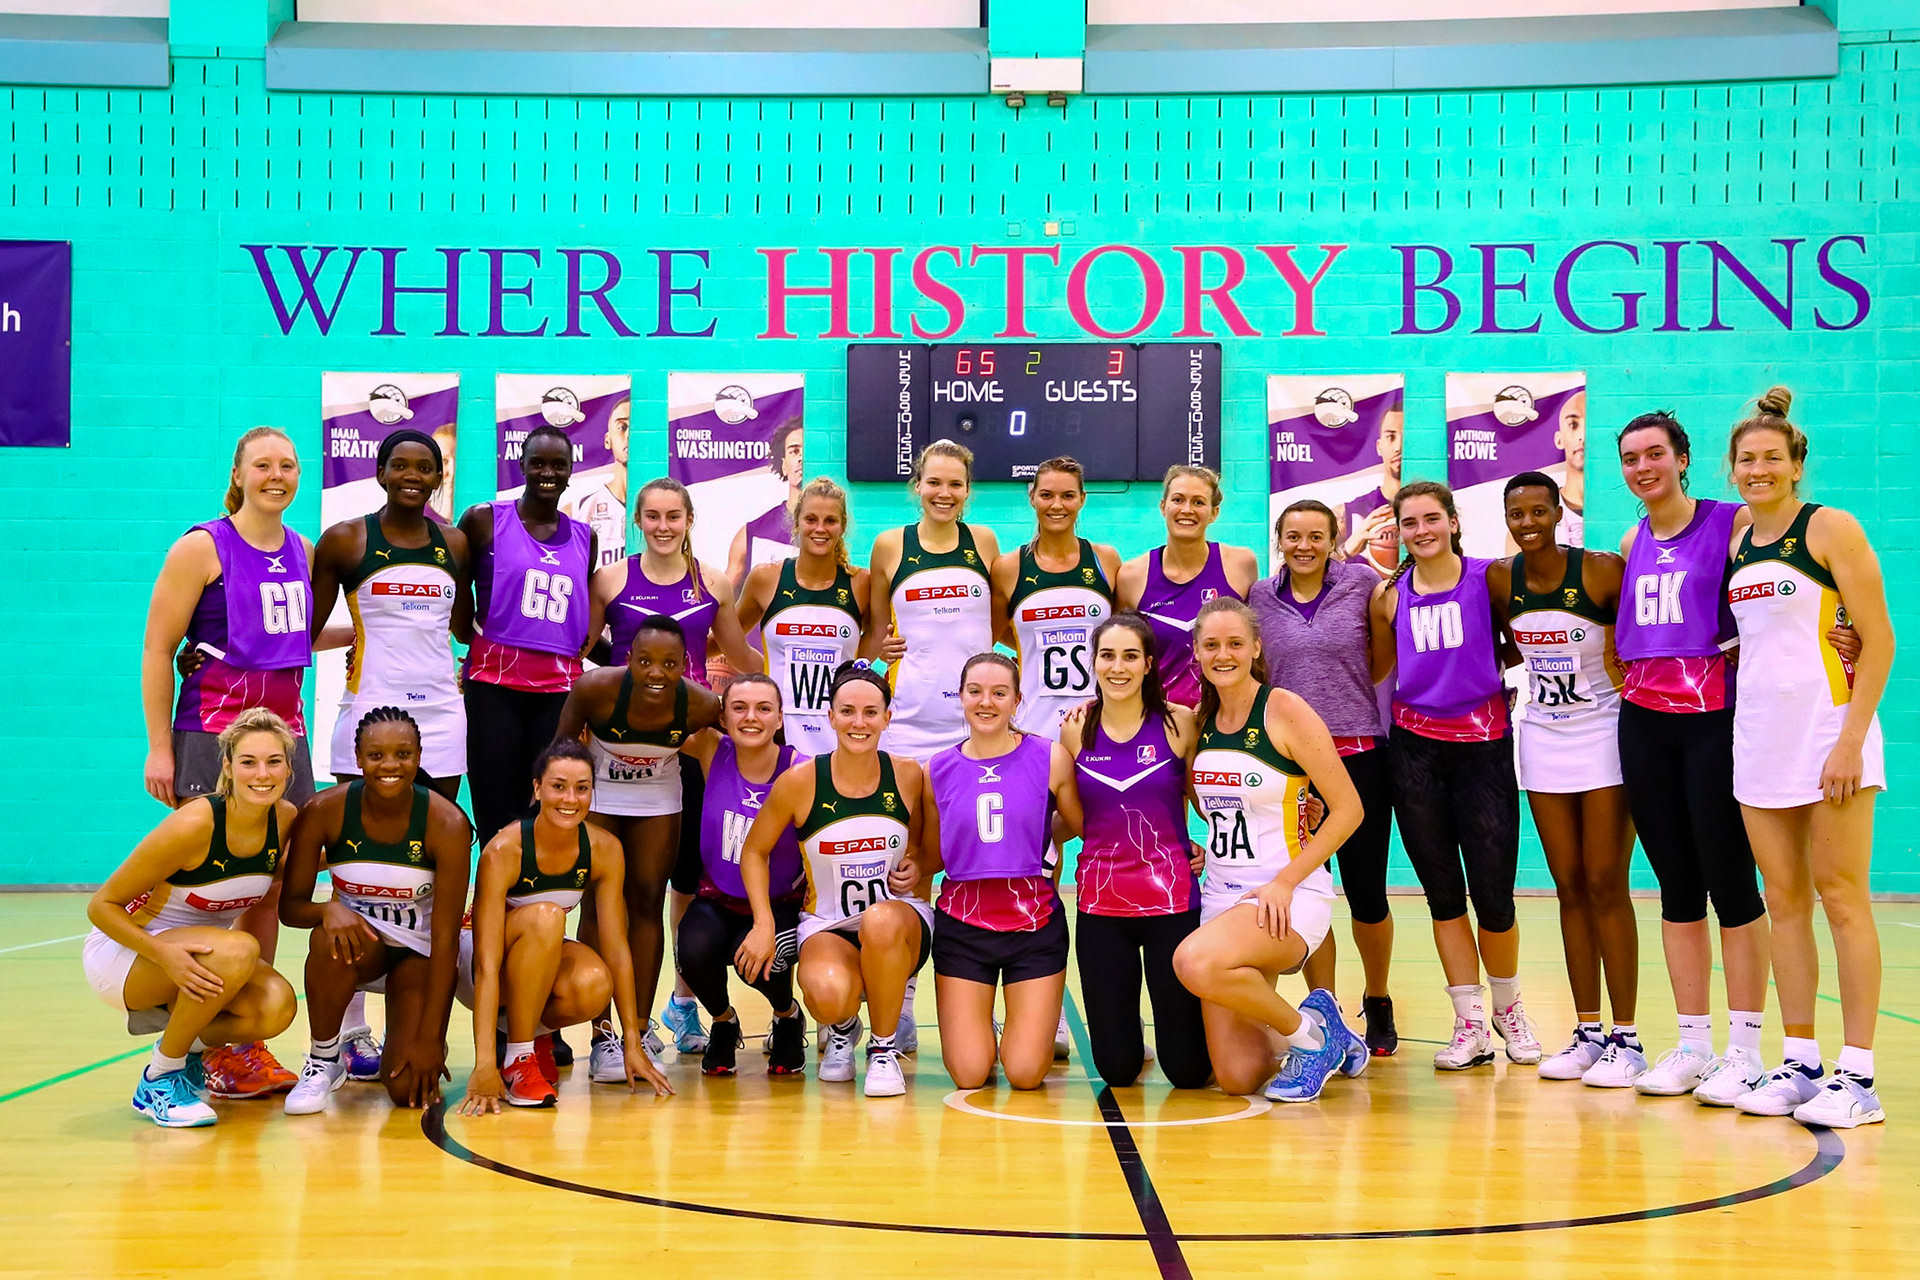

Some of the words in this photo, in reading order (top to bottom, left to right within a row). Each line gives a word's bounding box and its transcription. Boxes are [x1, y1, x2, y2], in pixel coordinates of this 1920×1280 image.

[240, 244, 718, 338] WHERE
[756, 244, 1347, 341] HISTORY
[1391, 235, 1872, 334] BEGINS
[2, 302, 21, 332] h
[956, 350, 995, 375] 65
[1025, 351, 1041, 375] 2
[1107, 350, 1123, 375] 3
[934, 380, 1004, 402] HOME
[1045, 380, 1137, 402] GUESTS
[1009, 410, 1027, 436] 0
[676, 429, 712, 440] CONNER
[1276, 432, 1295, 443] LEVI
[1454, 430, 1495, 443] ANTHONY
[331, 440, 381, 459] BRATK
[1276, 443, 1314, 463] NOEL
[1454, 442, 1498, 461] ROWE
[388, 584, 440, 597] SPAR
[520, 568, 574, 624] GS
[918, 586, 968, 599] SPAR
[1635, 570, 1688, 626] GK
[1731, 583, 1774, 601] SPAR
[259, 580, 306, 635] GD
[401, 602, 430, 611] Telkom
[933, 607, 961, 615] Telkom
[1035, 606, 1085, 619] SPAR
[789, 624, 836, 636] SPAR
[1409, 600, 1465, 653] WD
[1044, 630, 1085, 644] Telkom
[1521, 631, 1567, 643] SPAR
[793, 648, 835, 662] Telkom
[1043, 644, 1090, 692] GS
[1530, 658, 1573, 672] Telkom
[1194, 774, 1241, 785] SPAR
[1204, 797, 1243, 810] Telkom
[976, 792, 1004, 844] C
[1210, 810, 1255, 859] GA
[834, 840, 886, 853] SPAR
[841, 864, 884, 877] Telkom
[345, 883, 411, 898] SPAR
[841, 878, 890, 918] GD
